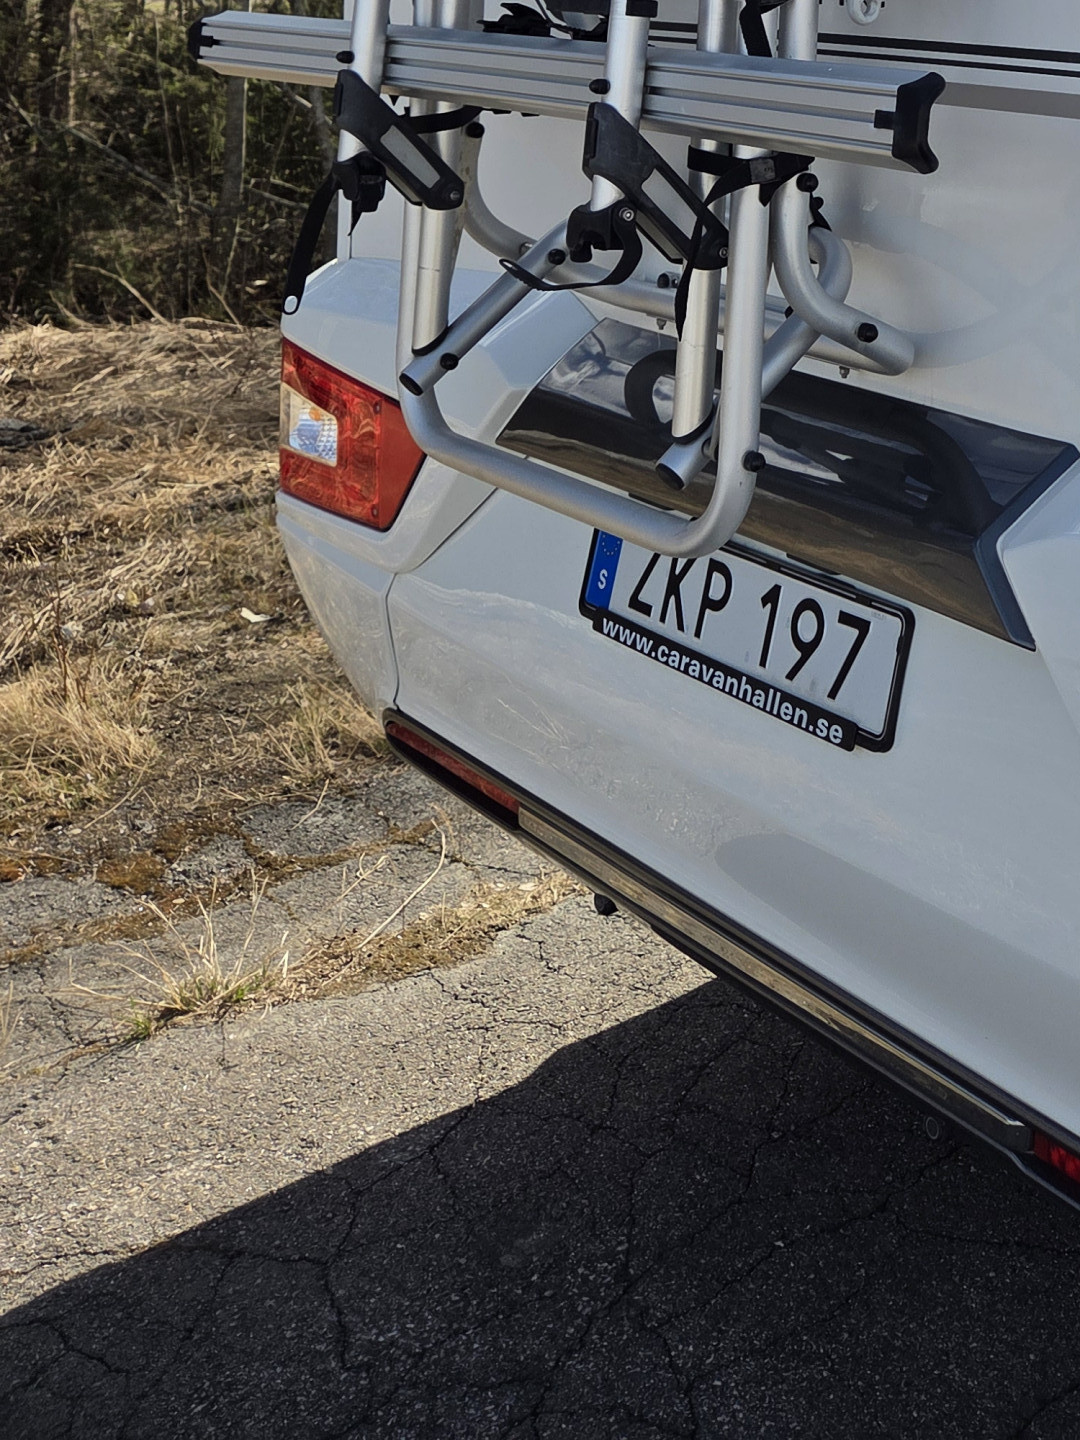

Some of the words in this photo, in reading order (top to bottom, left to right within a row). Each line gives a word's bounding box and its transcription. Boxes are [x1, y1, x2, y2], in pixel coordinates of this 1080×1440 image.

[597, 569, 608, 590] S
[602, 617, 844, 744] www.caravanhallen.se
[760, 583, 872, 701] 197
